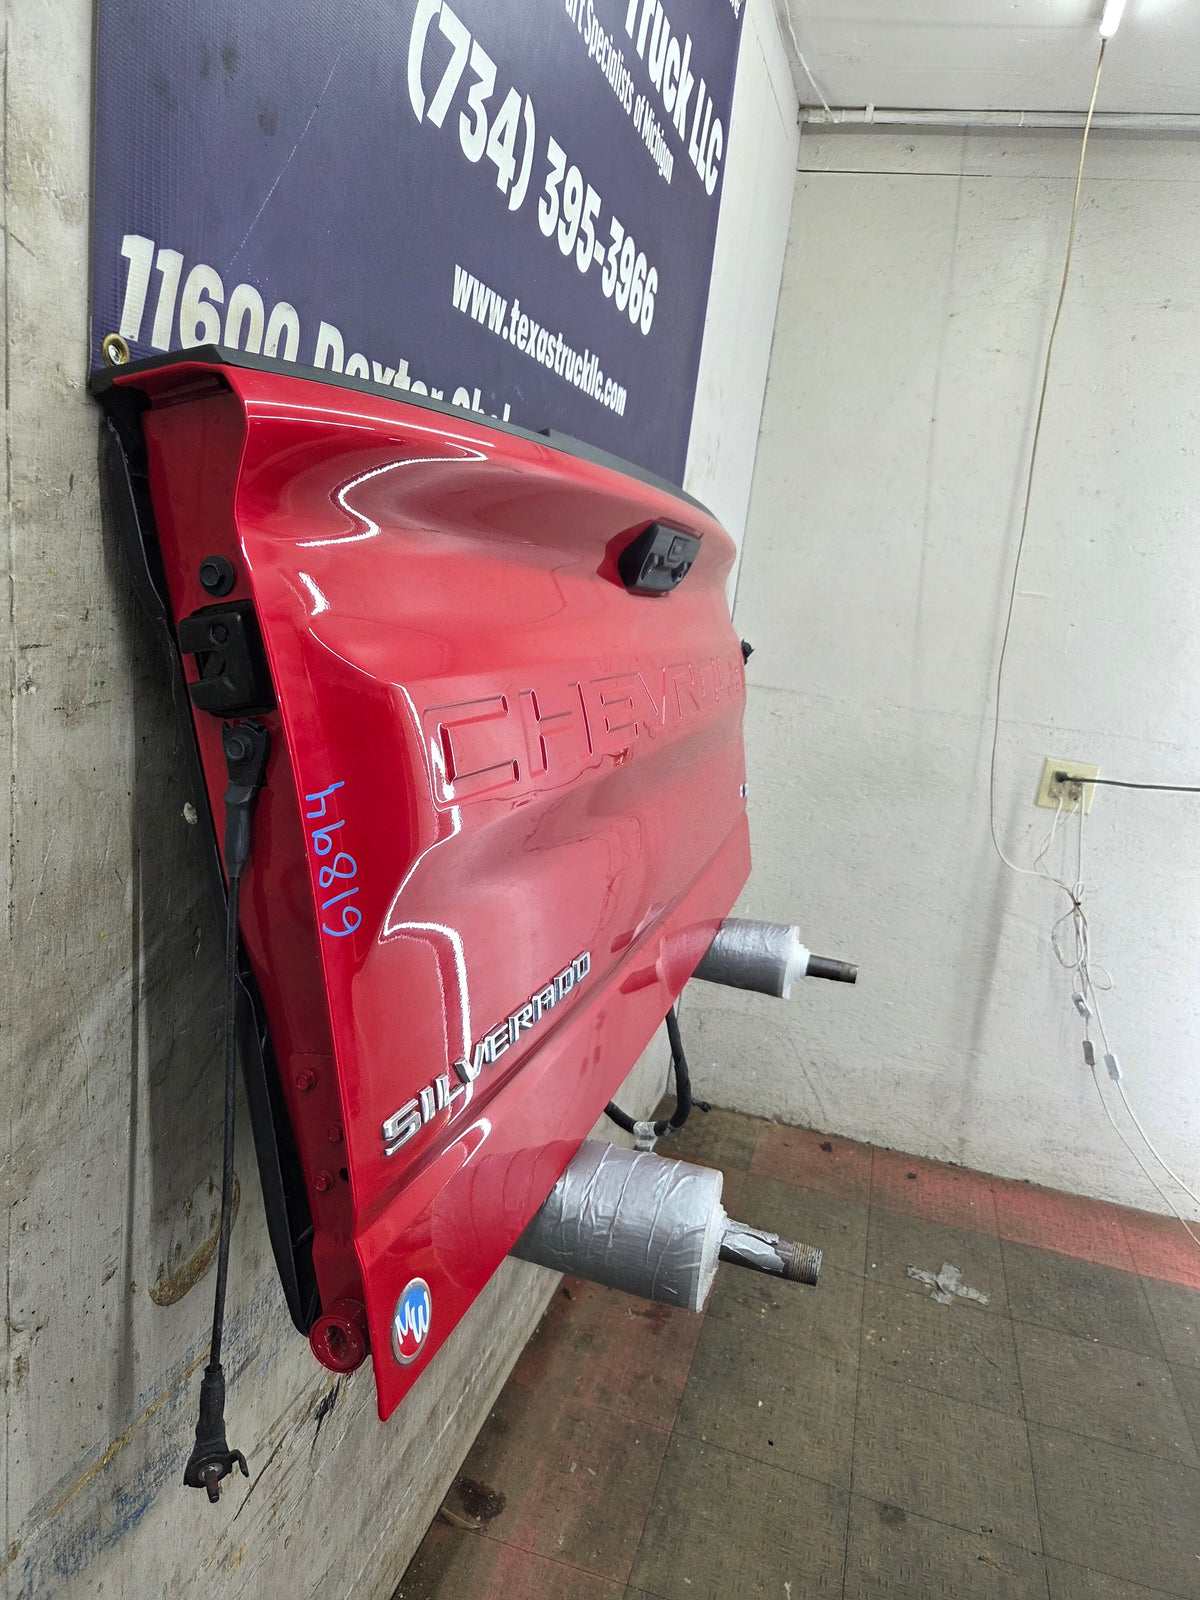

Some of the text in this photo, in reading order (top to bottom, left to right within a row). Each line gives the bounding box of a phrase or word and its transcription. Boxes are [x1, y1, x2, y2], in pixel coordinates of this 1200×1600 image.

[407, 0, 535, 211] (734)
[538, 136, 658, 335] 395-3966
[584, 0, 634, 115] Specialists
[633, 95, 647, 133] of
[642, 100, 674, 185] Michigan
[688, 78, 723, 195] LLC
[452, 264, 627, 417] www.texastruckllc.com
[382, 951, 590, 1156] SILVERADO
